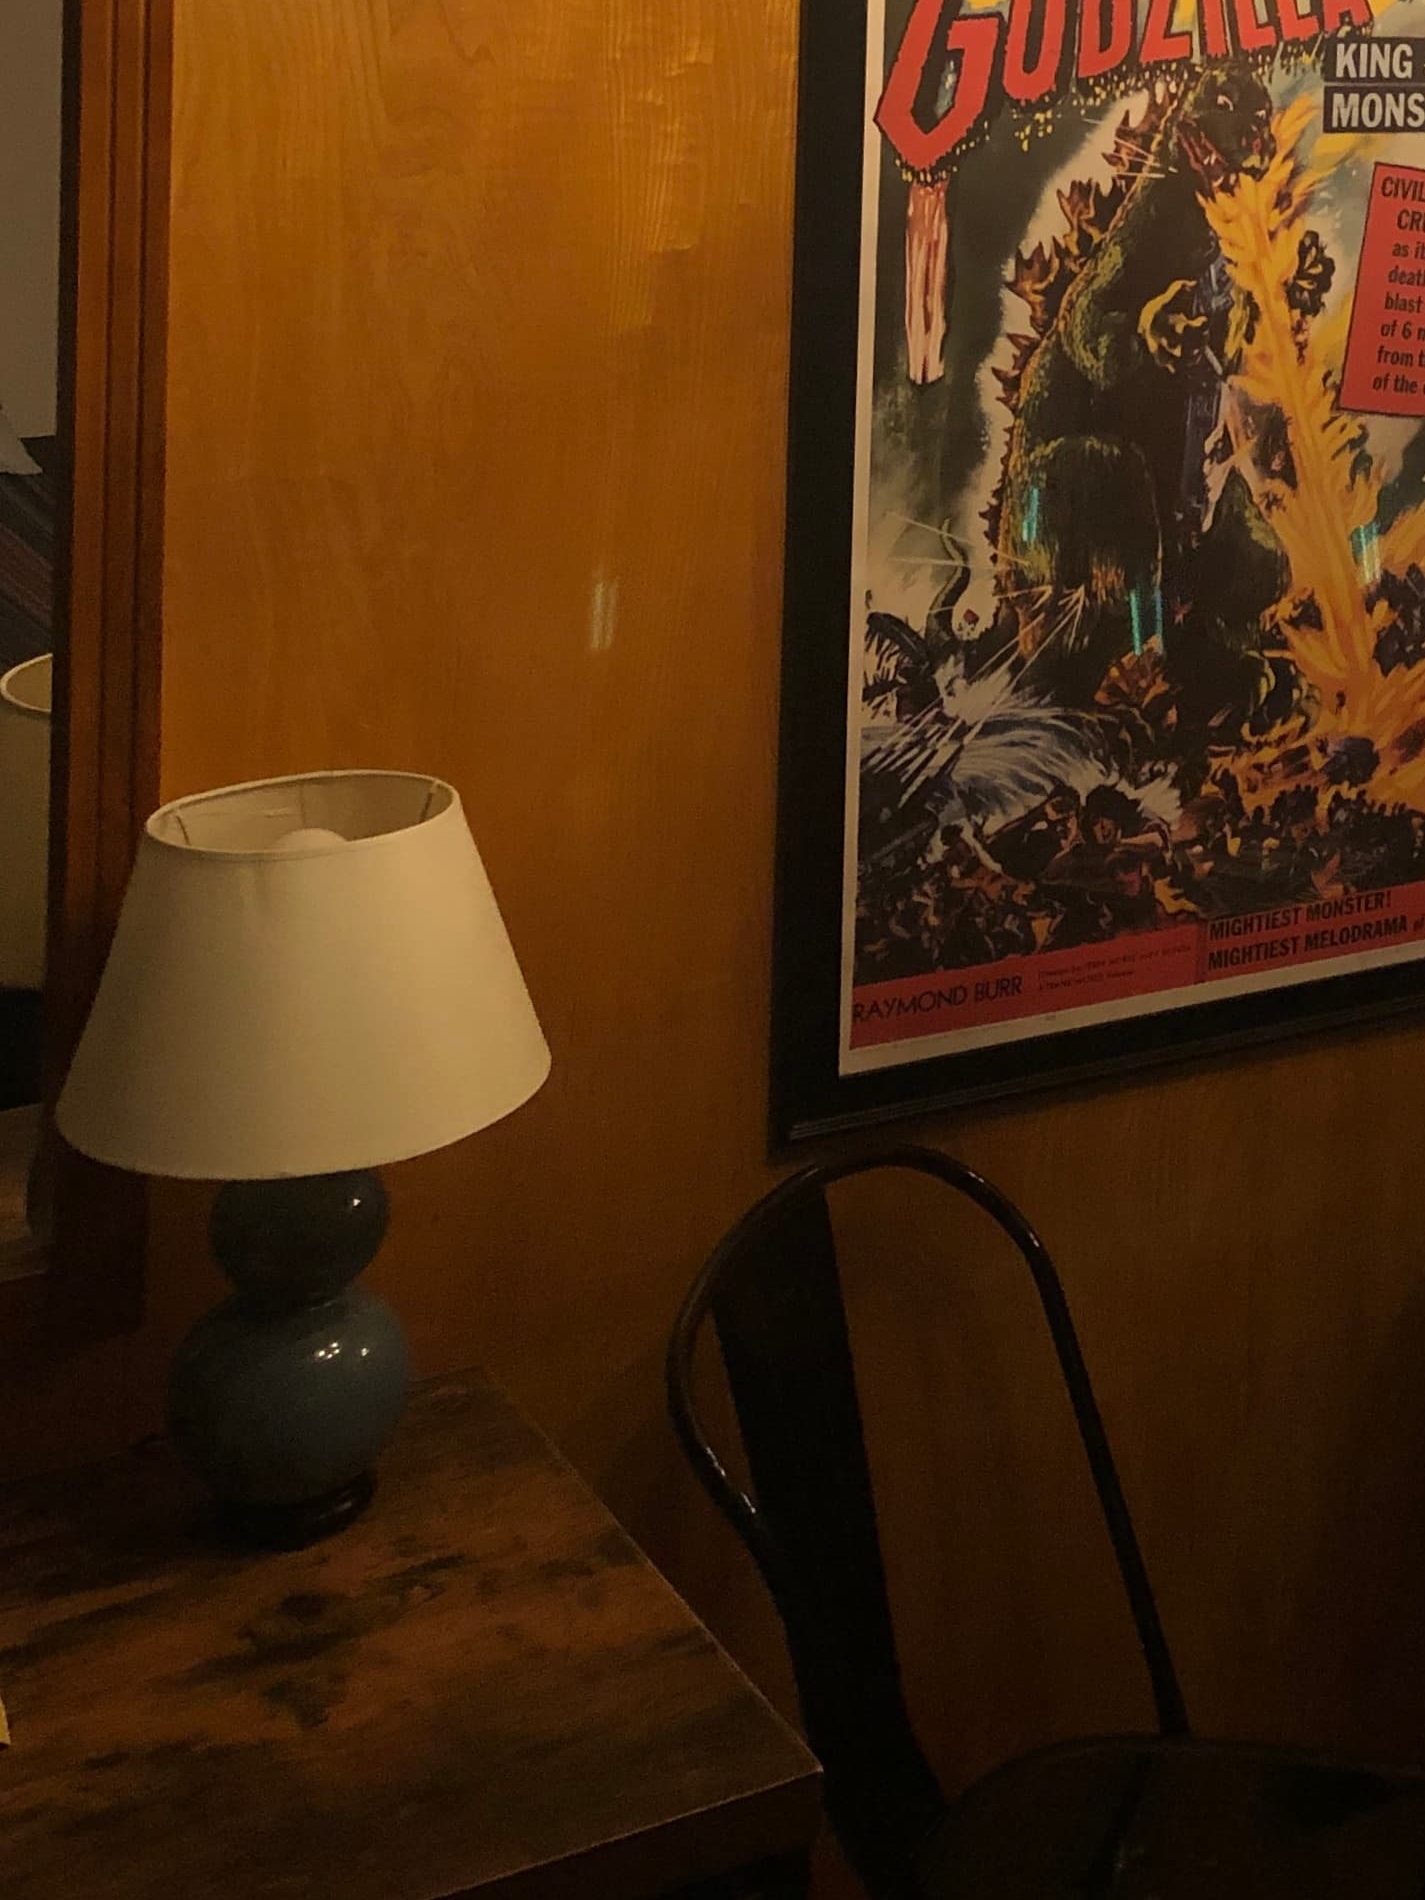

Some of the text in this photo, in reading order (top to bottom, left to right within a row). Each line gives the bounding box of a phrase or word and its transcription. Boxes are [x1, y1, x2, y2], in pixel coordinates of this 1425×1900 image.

[1335, 42, 1413, 79] KING
[1392, 242, 1409, 257] as
[1384, 292, 1423, 314] blast
[1380, 319, 1396, 337] of
[1402, 321, 1412, 340] 6
[1377, 345, 1414, 367] from
[1373, 371, 1391, 391] of
[1394, 374, 1418, 395] the
[1209, 890, 1392, 941] MIGHTIEST MONSTER!
[1208, 938, 1300, 970] MIGHTIEST
[1304, 914, 1408, 952] MELODRAMA
[853, 984, 968, 1024] RAYMOND
[974, 975, 1023, 1003] BURR
